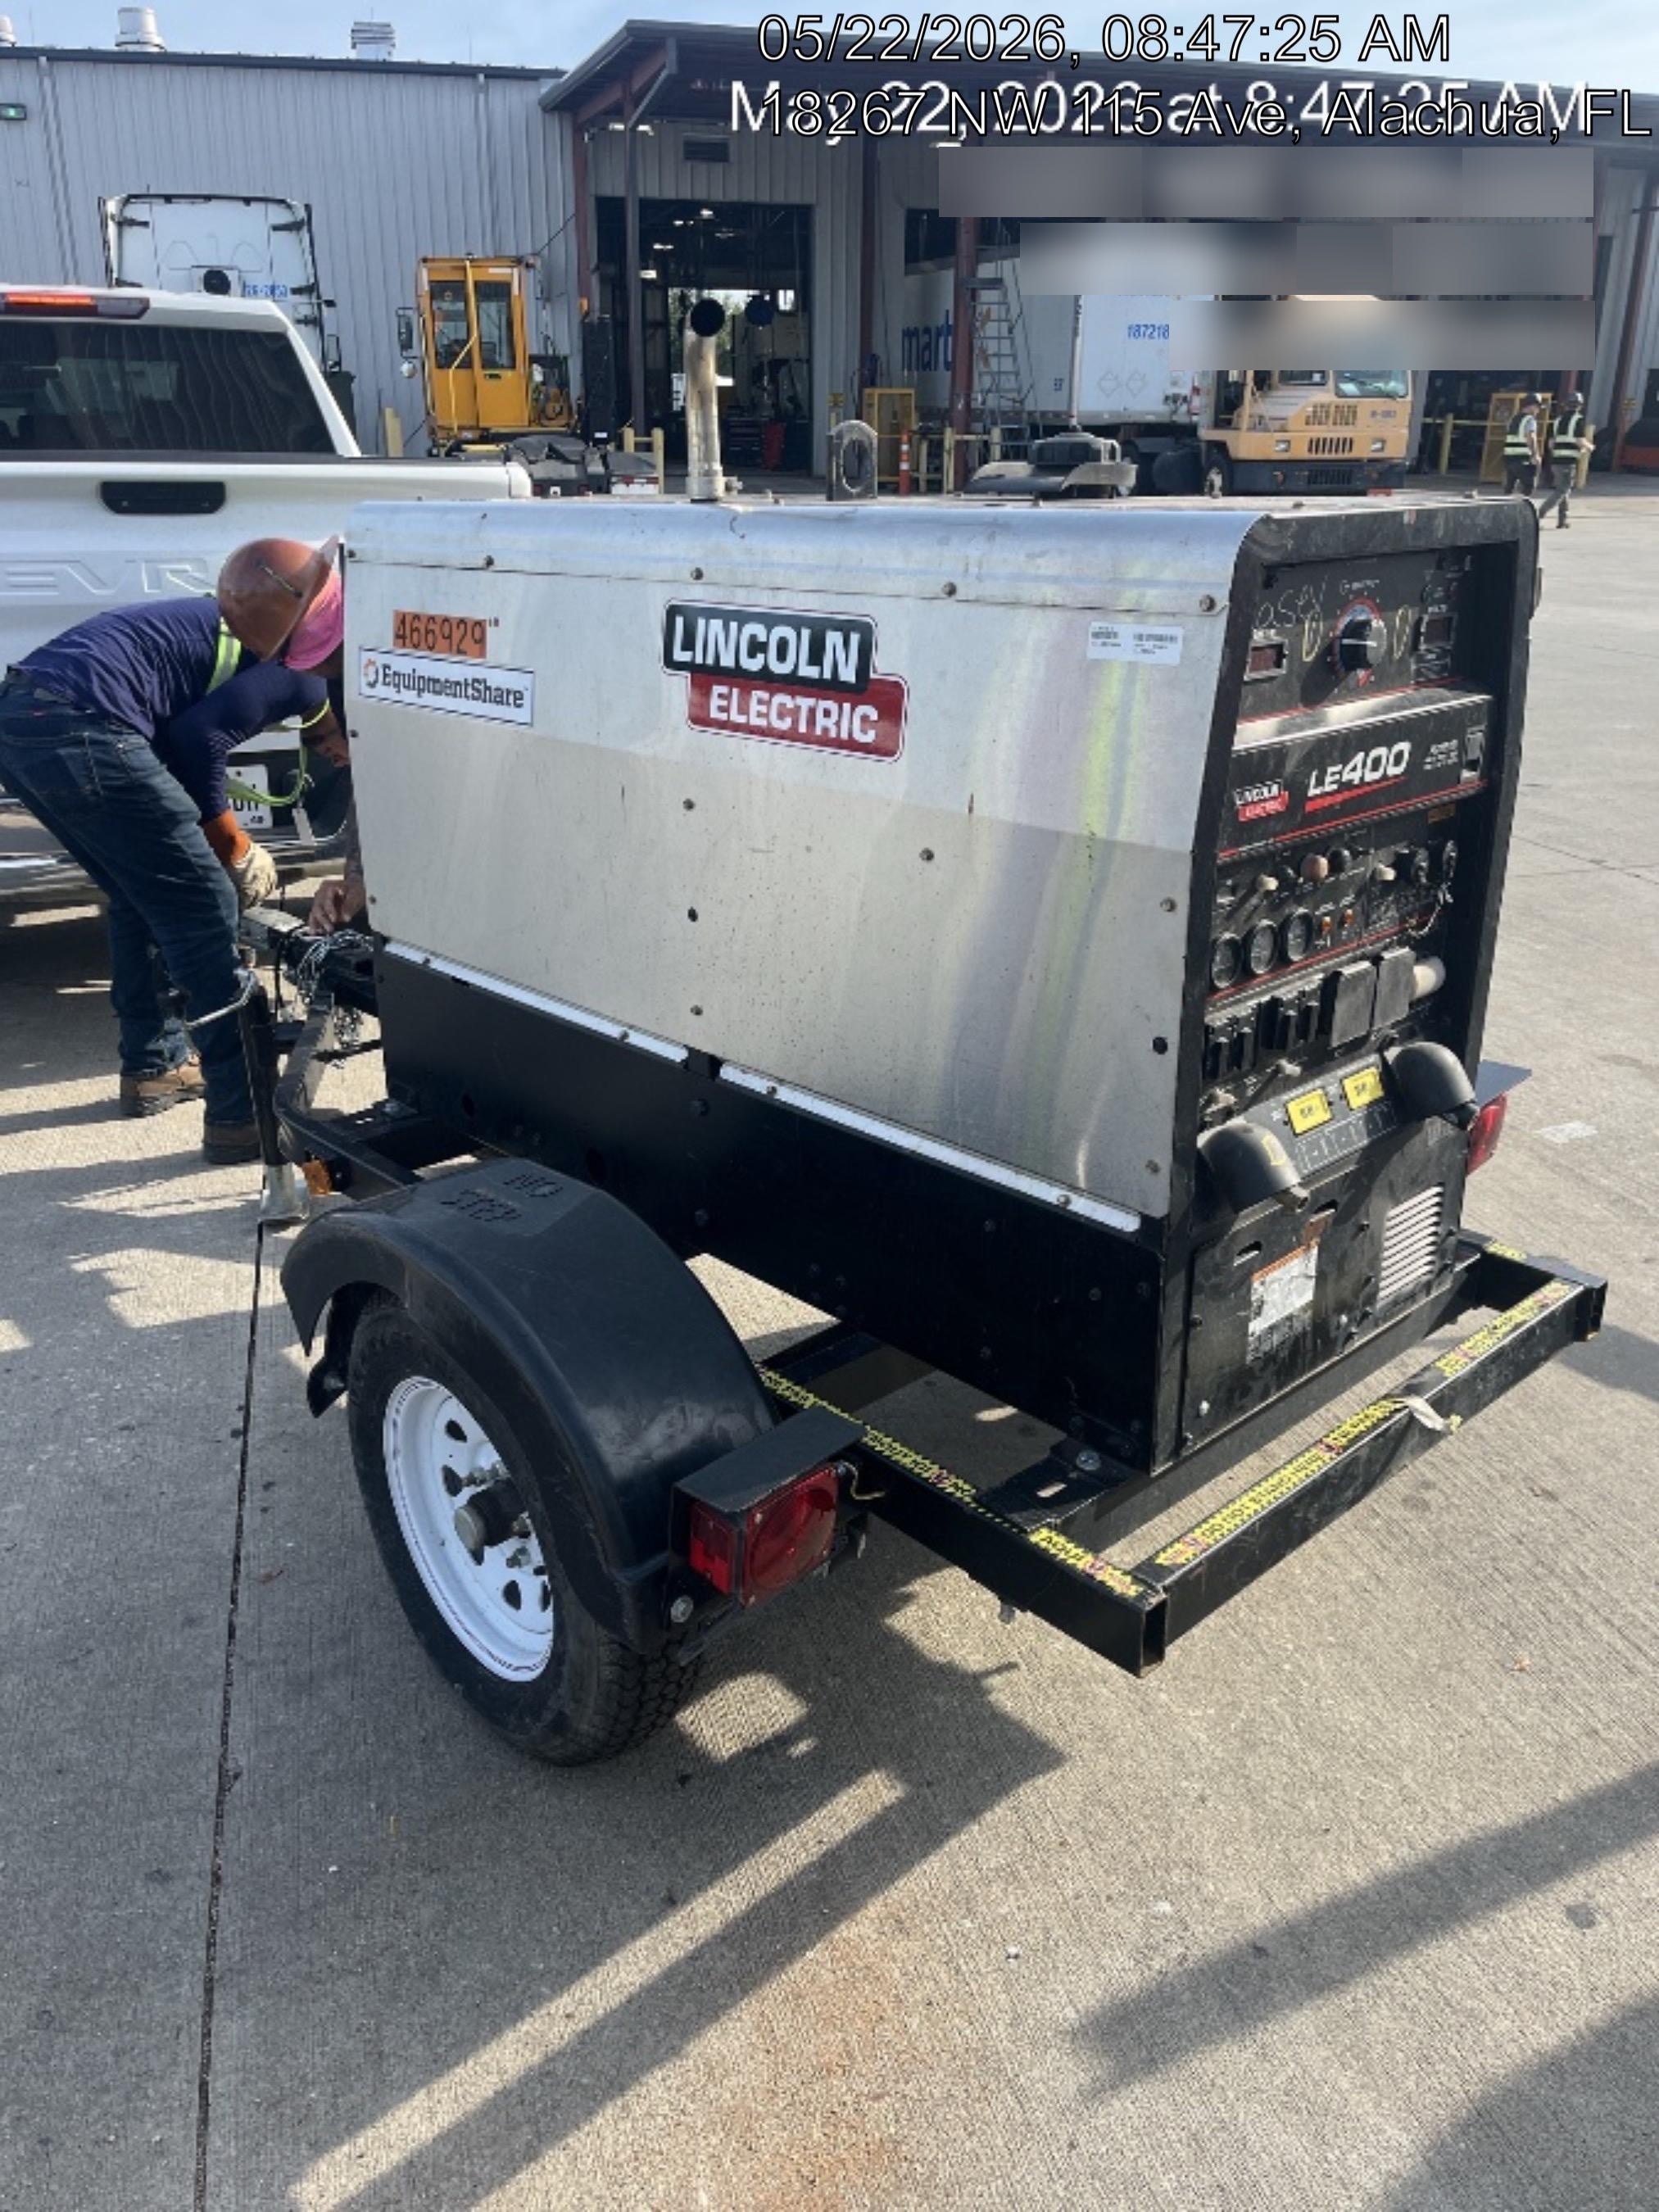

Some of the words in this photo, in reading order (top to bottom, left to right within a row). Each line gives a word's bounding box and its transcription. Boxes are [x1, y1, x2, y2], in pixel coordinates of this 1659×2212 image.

[672, 614, 861, 684] LINCOLN
[381, 663, 525, 709] EquipmentShare
[709, 684, 879, 744] ELECTRIC
[1307, 741, 1412, 797] LE400
